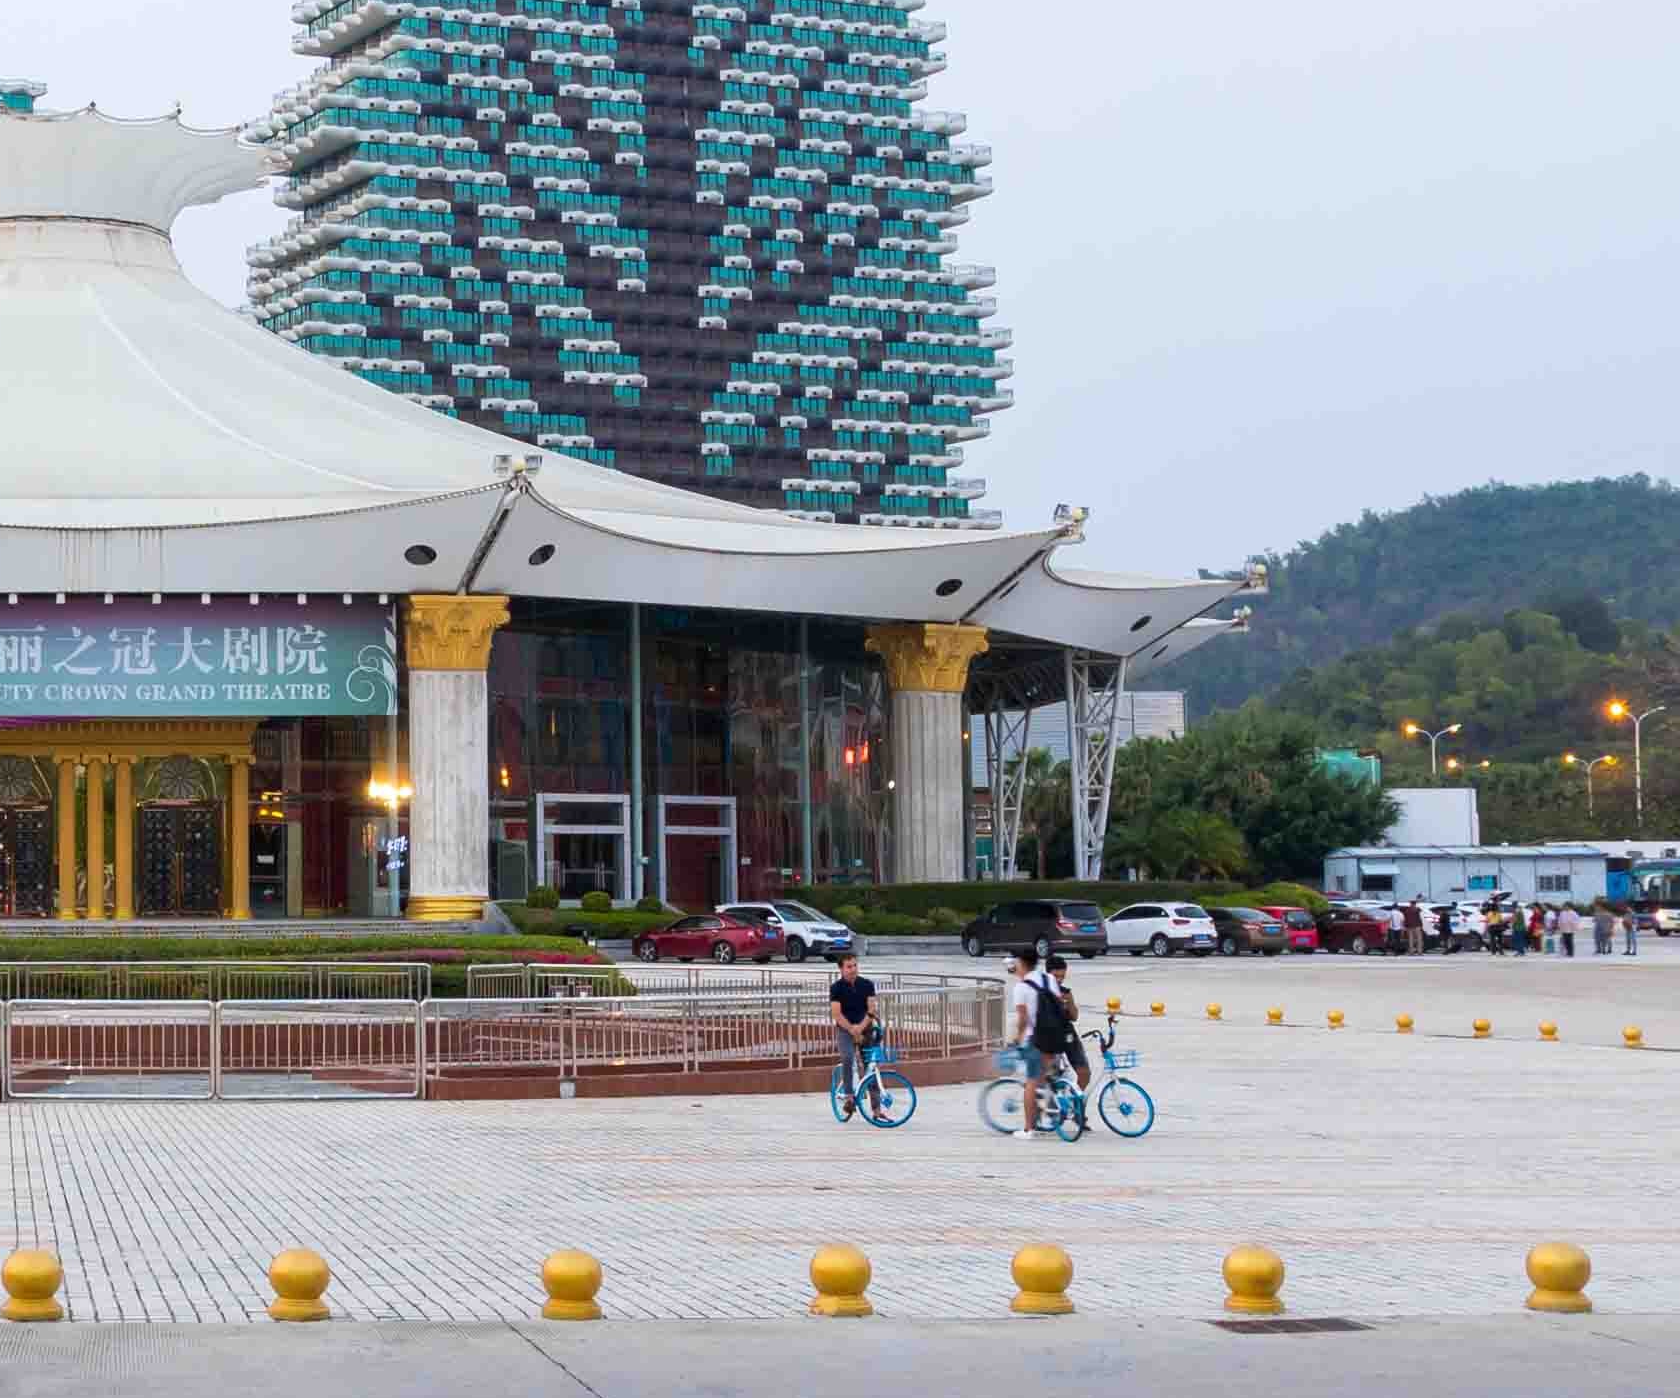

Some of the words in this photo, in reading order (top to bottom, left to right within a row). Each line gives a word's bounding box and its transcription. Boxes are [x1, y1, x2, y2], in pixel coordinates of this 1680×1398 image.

[45, 683, 127, 700] CROWN
[136, 683, 214, 700] GRAND
[222, 683, 330, 700] THEATRE
